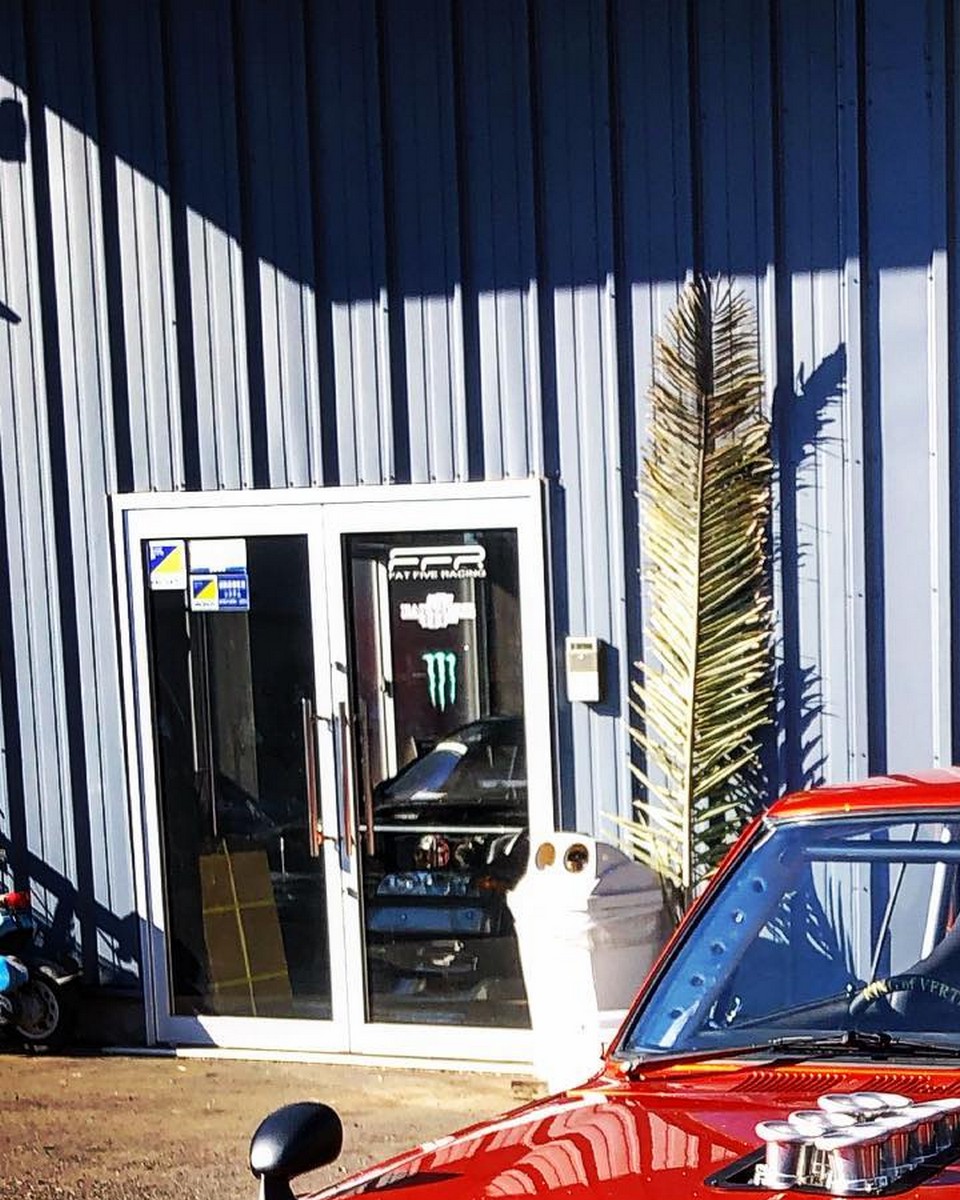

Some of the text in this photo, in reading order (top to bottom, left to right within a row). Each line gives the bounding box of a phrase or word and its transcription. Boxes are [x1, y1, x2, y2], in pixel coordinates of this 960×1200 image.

[388, 568, 487, 580] FAT FIVE RACING
